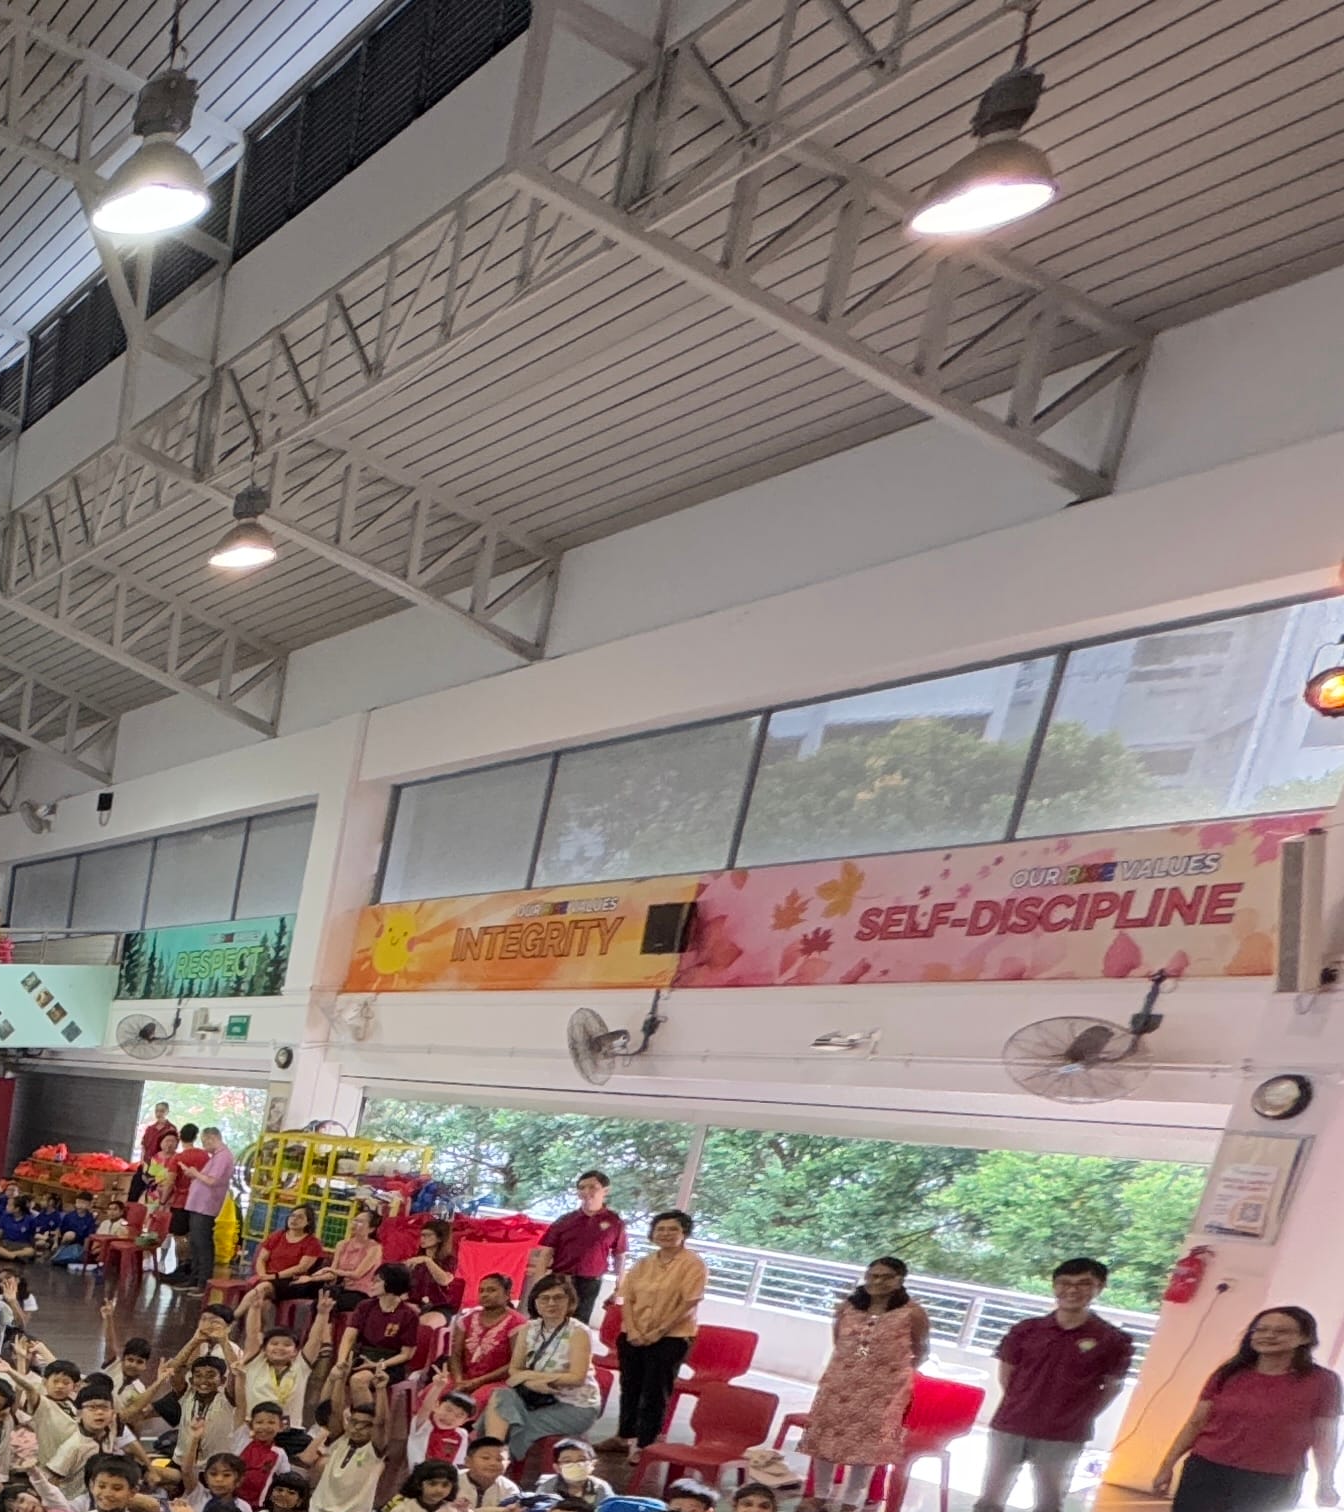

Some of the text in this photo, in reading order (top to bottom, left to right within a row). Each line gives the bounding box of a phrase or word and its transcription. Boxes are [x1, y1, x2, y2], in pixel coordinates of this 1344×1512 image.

[1012, 866, 1061, 889] OUR
[1118, 852, 1222, 881] VALUES
[515, 903, 542, 918] OUR
[568, 896, 619, 914] VALUES
[855, 881, 1245, 942] SELF-DISCIPLINE
[449, 915, 627, 962] INTEGRITY
[175, 945, 265, 980] RESPECT
